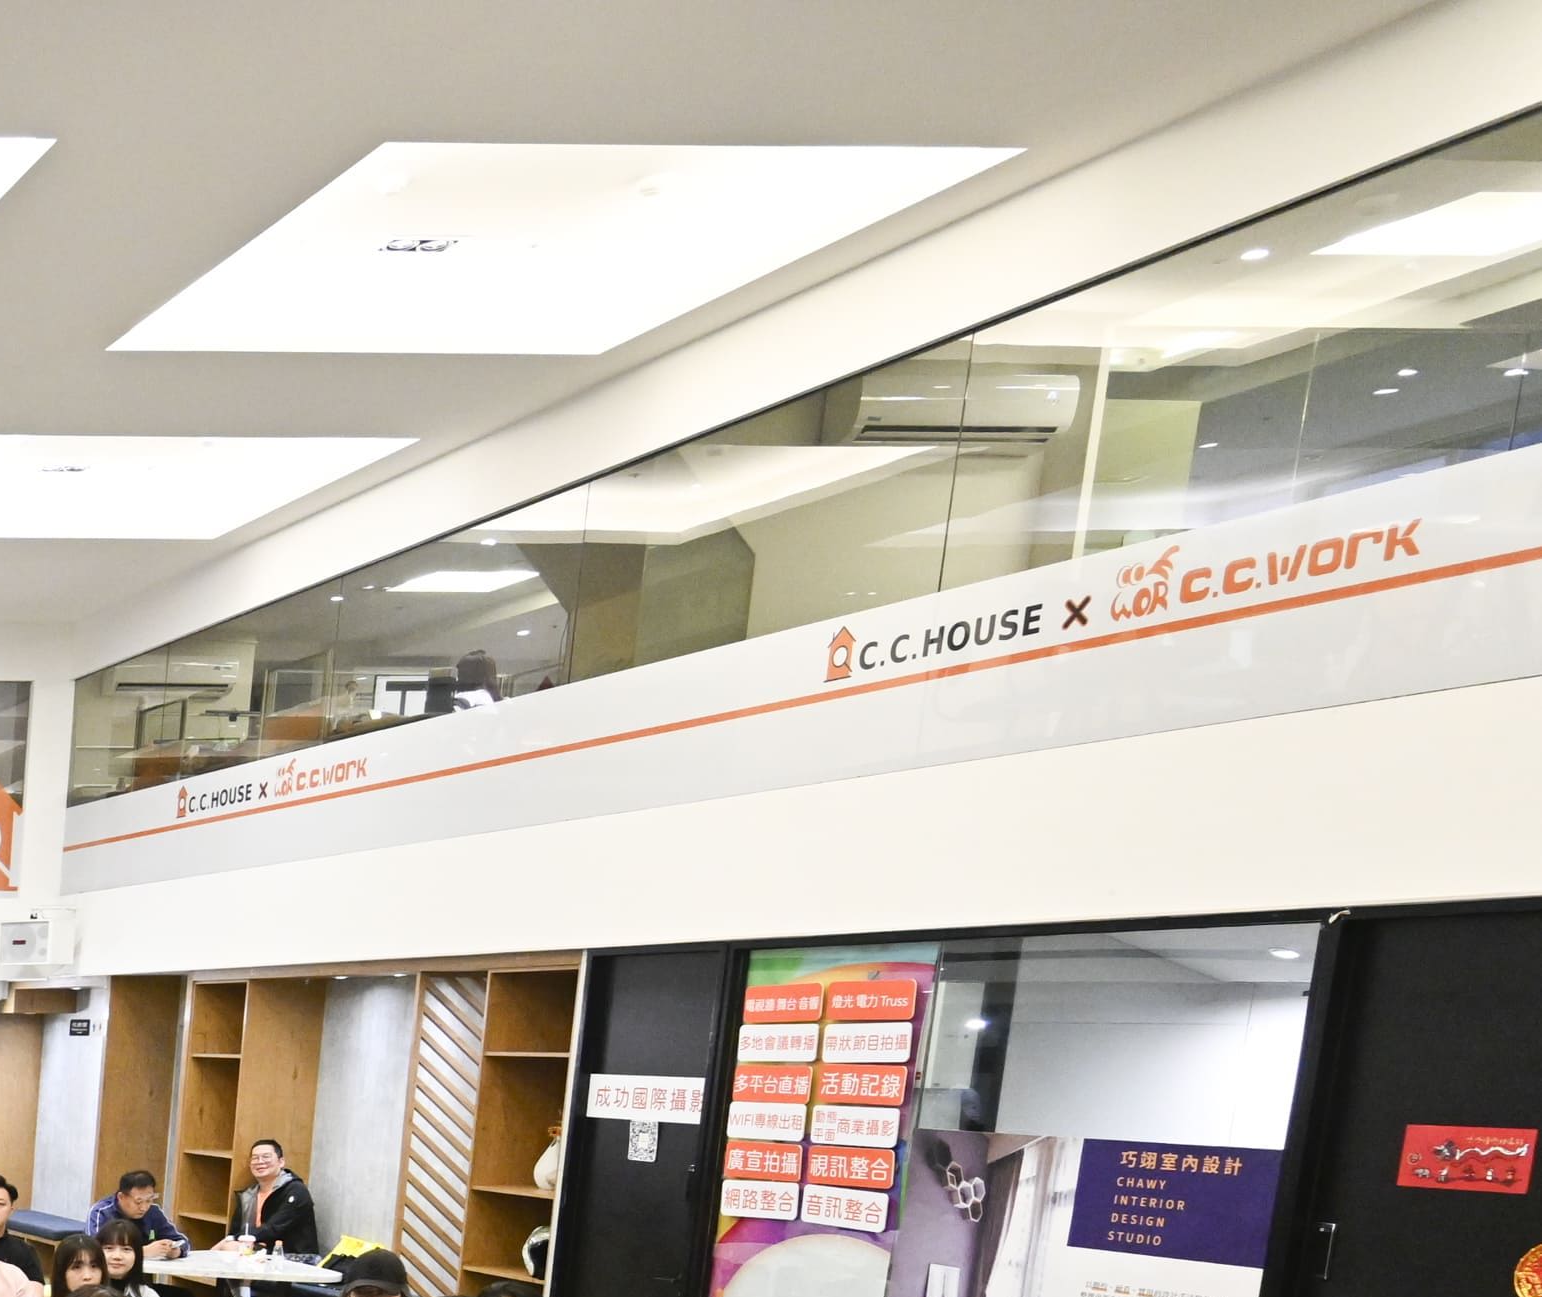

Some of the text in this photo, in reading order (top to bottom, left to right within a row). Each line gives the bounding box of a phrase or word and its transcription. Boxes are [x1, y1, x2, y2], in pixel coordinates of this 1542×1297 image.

[858, 603, 1043, 670] C.C.HOUSE
[188, 783, 252, 813] C.C.HOUSE
[856, 995, 877, 1009] 電力
[881, 995, 909, 1008] Truss
[734, 1074, 810, 1095] 多平台直播
[820, 1072, 901, 1098] 活動記錄
[836, 1116, 894, 1137] 商業攝影
[728, 1149, 798, 1175] 廣宣拍攝
[811, 1153, 890, 1181] 視訊整合
[1116, 1177, 1166, 1190] CHAWY
[725, 1189, 795, 1212] 網路整合
[806, 1194, 883, 1225] 音訊整合
[1114, 1195, 1185, 1210] INTERIOR
[1111, 1213, 1165, 1227] DESIGN
[1107, 1231, 1162, 1246] STUDIO
